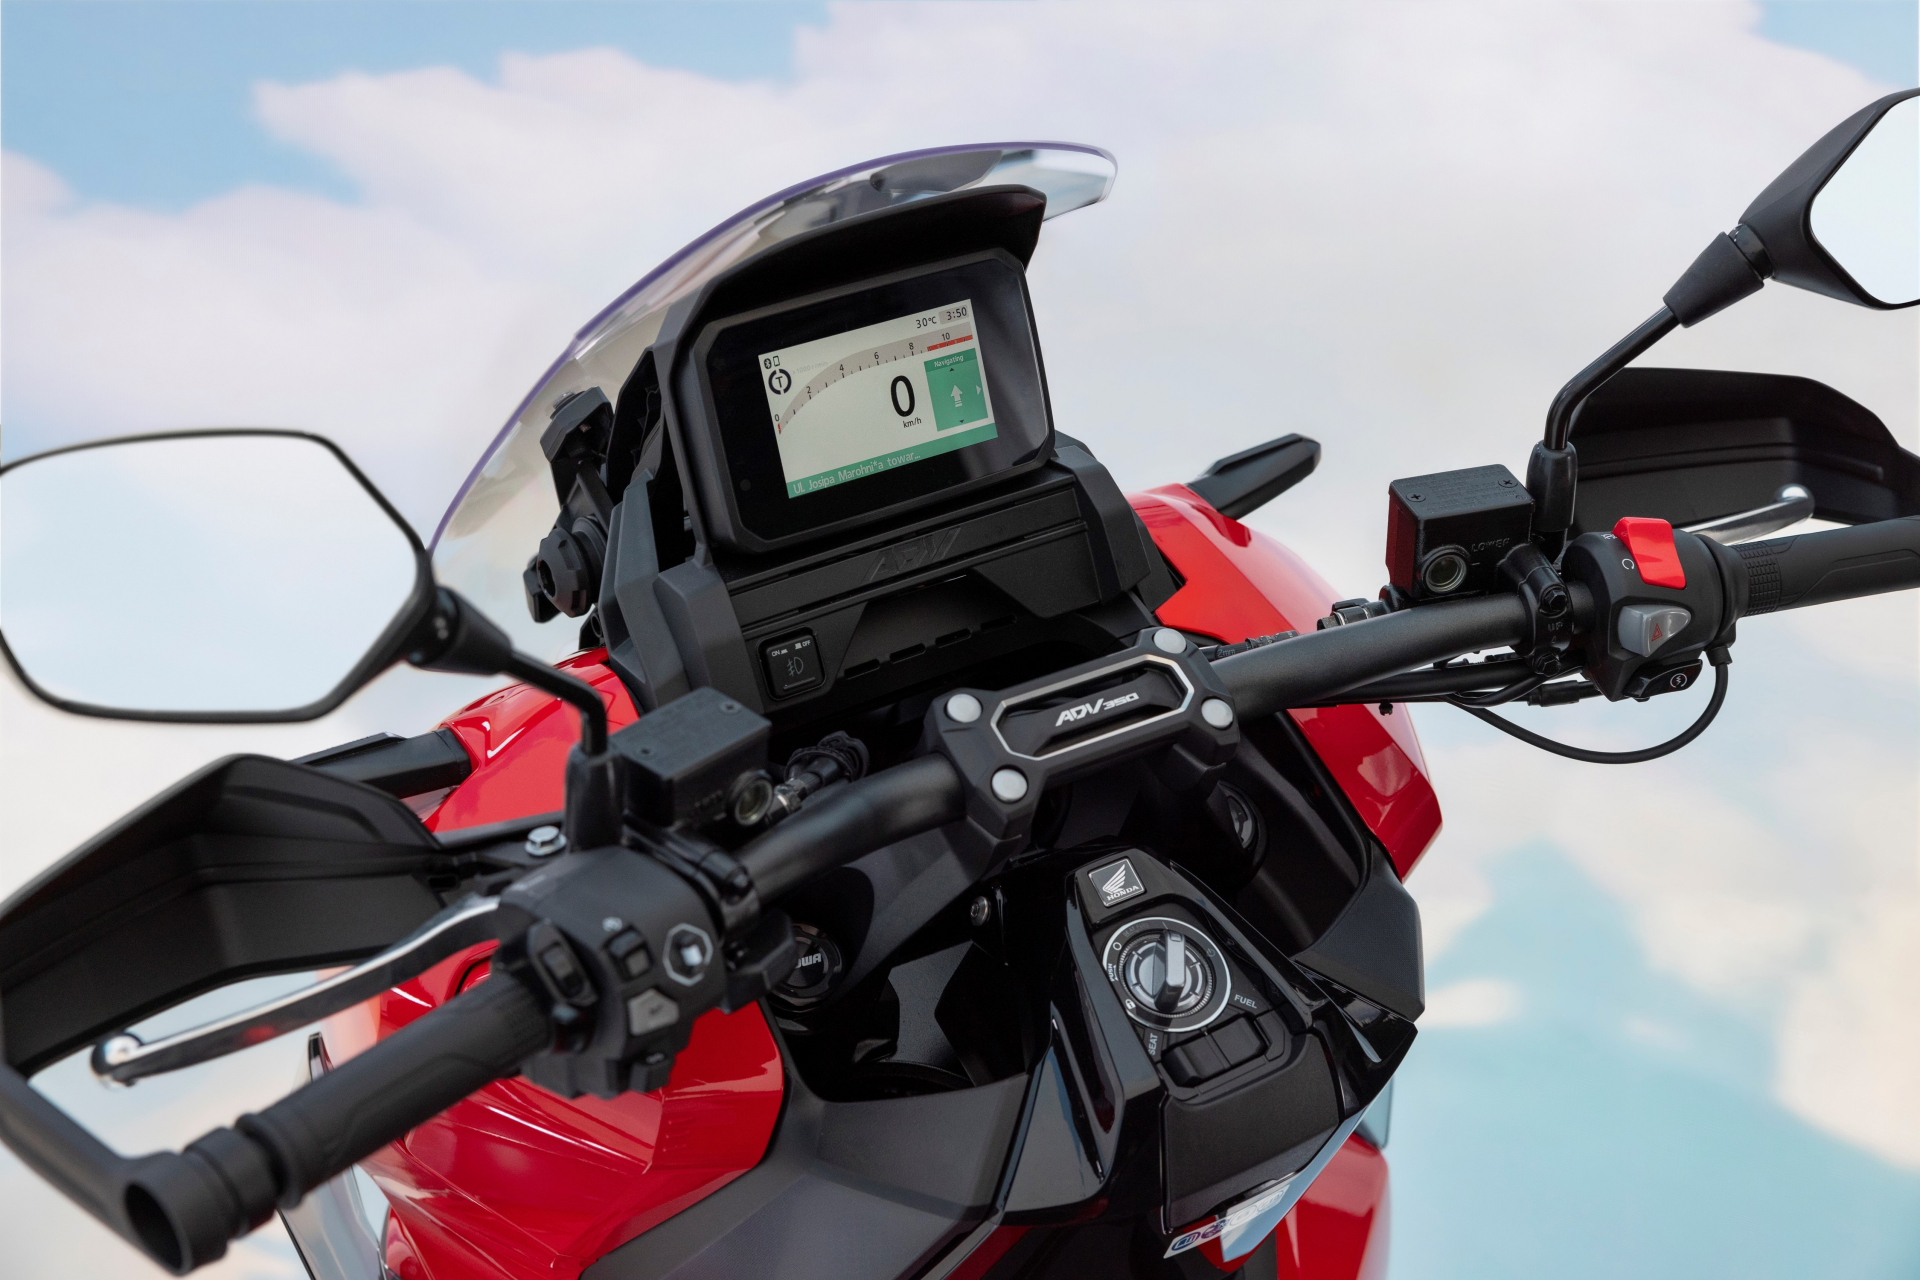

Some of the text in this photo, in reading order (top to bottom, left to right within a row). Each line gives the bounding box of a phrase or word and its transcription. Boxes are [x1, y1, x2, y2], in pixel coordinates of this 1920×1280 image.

[946, 306, 967, 321] 3:50
[942, 332, 950, 341] 10
[908, 342, 914, 350] 8
[874, 352, 879, 360] 6
[933, 355, 964, 368] Navigating
[839, 364, 844, 372] 4
[806, 386, 811, 394] 2
[890, 375, 916, 417] 0
[774, 414, 780, 422] 0
[902, 417, 922, 428] km/h
[808, 474, 836, 491] Josipa
[802, 639, 811, 647] OFF
[771, 649, 781, 657] ON
[1106, 885, 1140, 901] HONDA
[1234, 994, 1257, 1009] FUEL
[1148, 1033, 1158, 1056] SEAT
